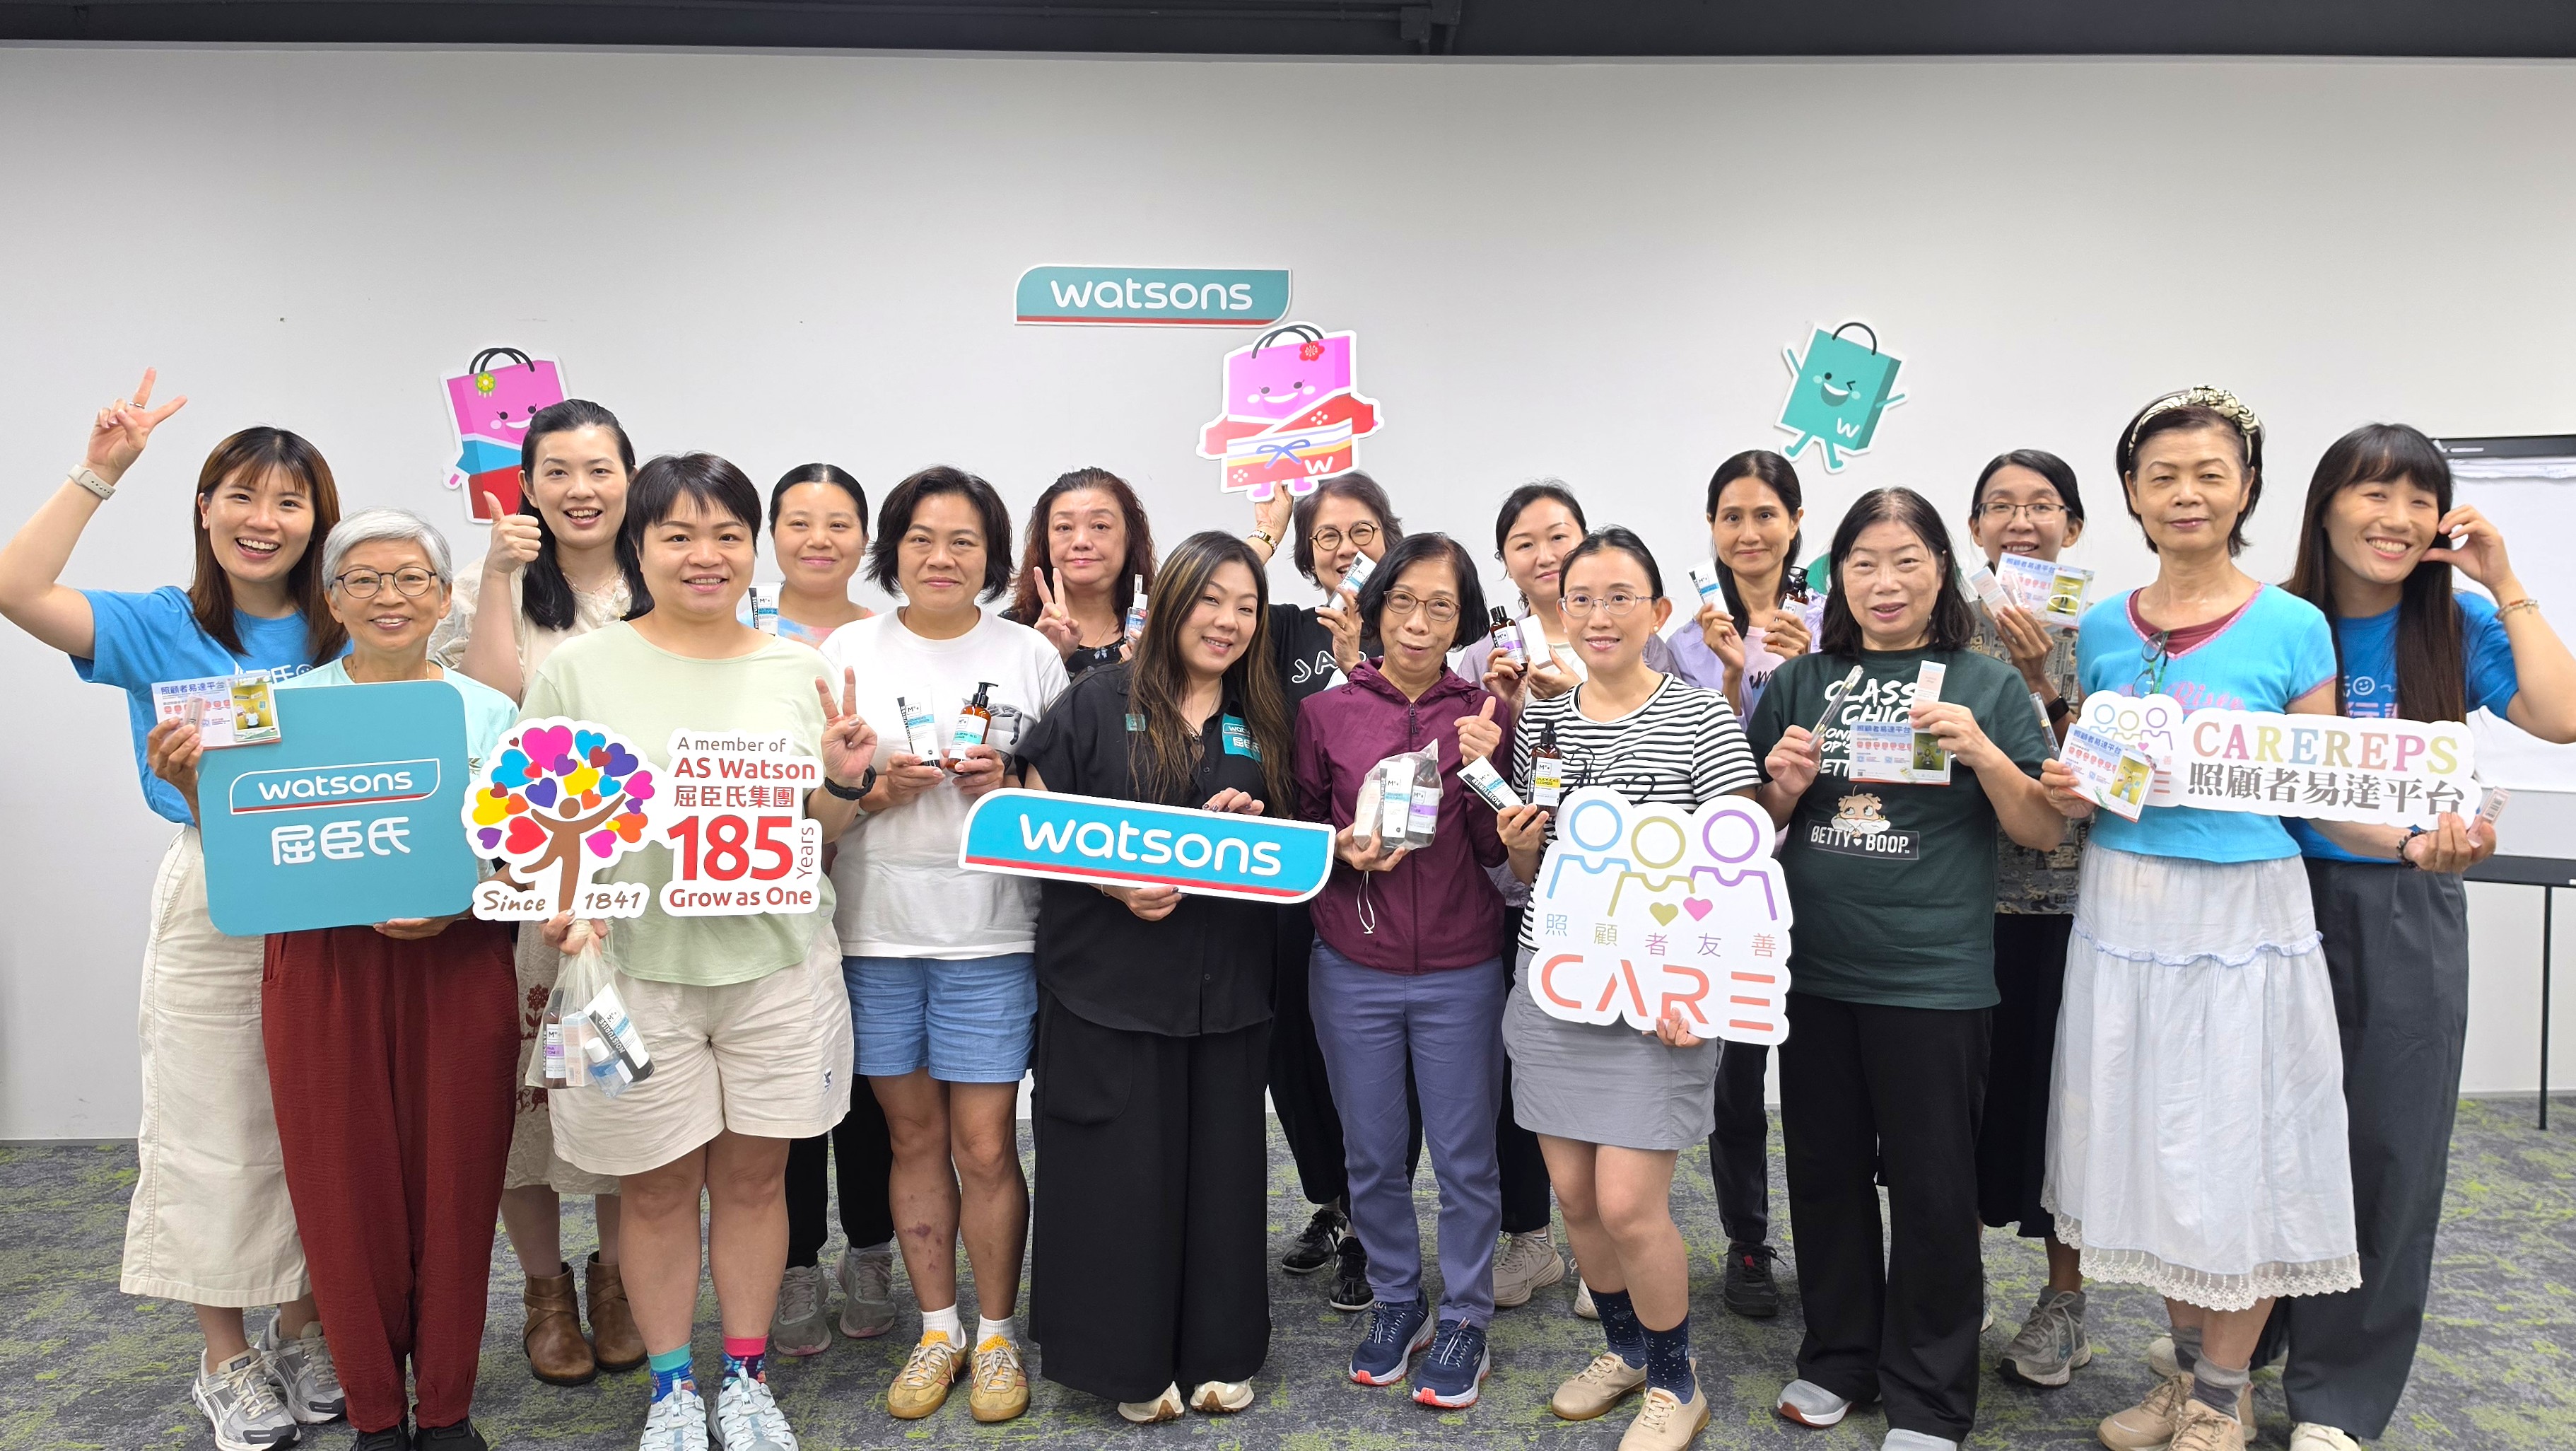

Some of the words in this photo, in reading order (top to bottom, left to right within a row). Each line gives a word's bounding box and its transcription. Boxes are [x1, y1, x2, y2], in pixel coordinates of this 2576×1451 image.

[1050, 278, 1253, 310] watsons
[677, 737, 690, 750] A
[695, 737, 766, 752] member
[769, 738, 787, 752] of
[2193, 721, 2458, 775] CAREREPS
[257, 770, 414, 801] watsons
[674, 757, 711, 779] AS
[718, 758, 816, 780] Watson
[673, 785, 795, 808] 屈臣氏集團
[1471, 778, 1501, 806] MOISTURISE
[2188, 762, 2466, 816] 照顧者易達平台
[271, 815, 411, 866] 屈臣氏
[666, 814, 794, 882] 185
[796, 826, 814, 880] Years
[1019, 813, 1281, 877] watsons
[1810, 825, 1851, 848] BETTY
[483, 890, 546, 912] Since
[585, 890, 641, 910] 1841
[669, 887, 733, 908] Grow
[735, 892, 761, 906] as
[766, 887, 813, 906] One
[1545, 913, 1776, 958] 照顧者友善
[1540, 952, 1776, 1032] CARE
[598, 1018, 626, 1054] MOISTURISE
